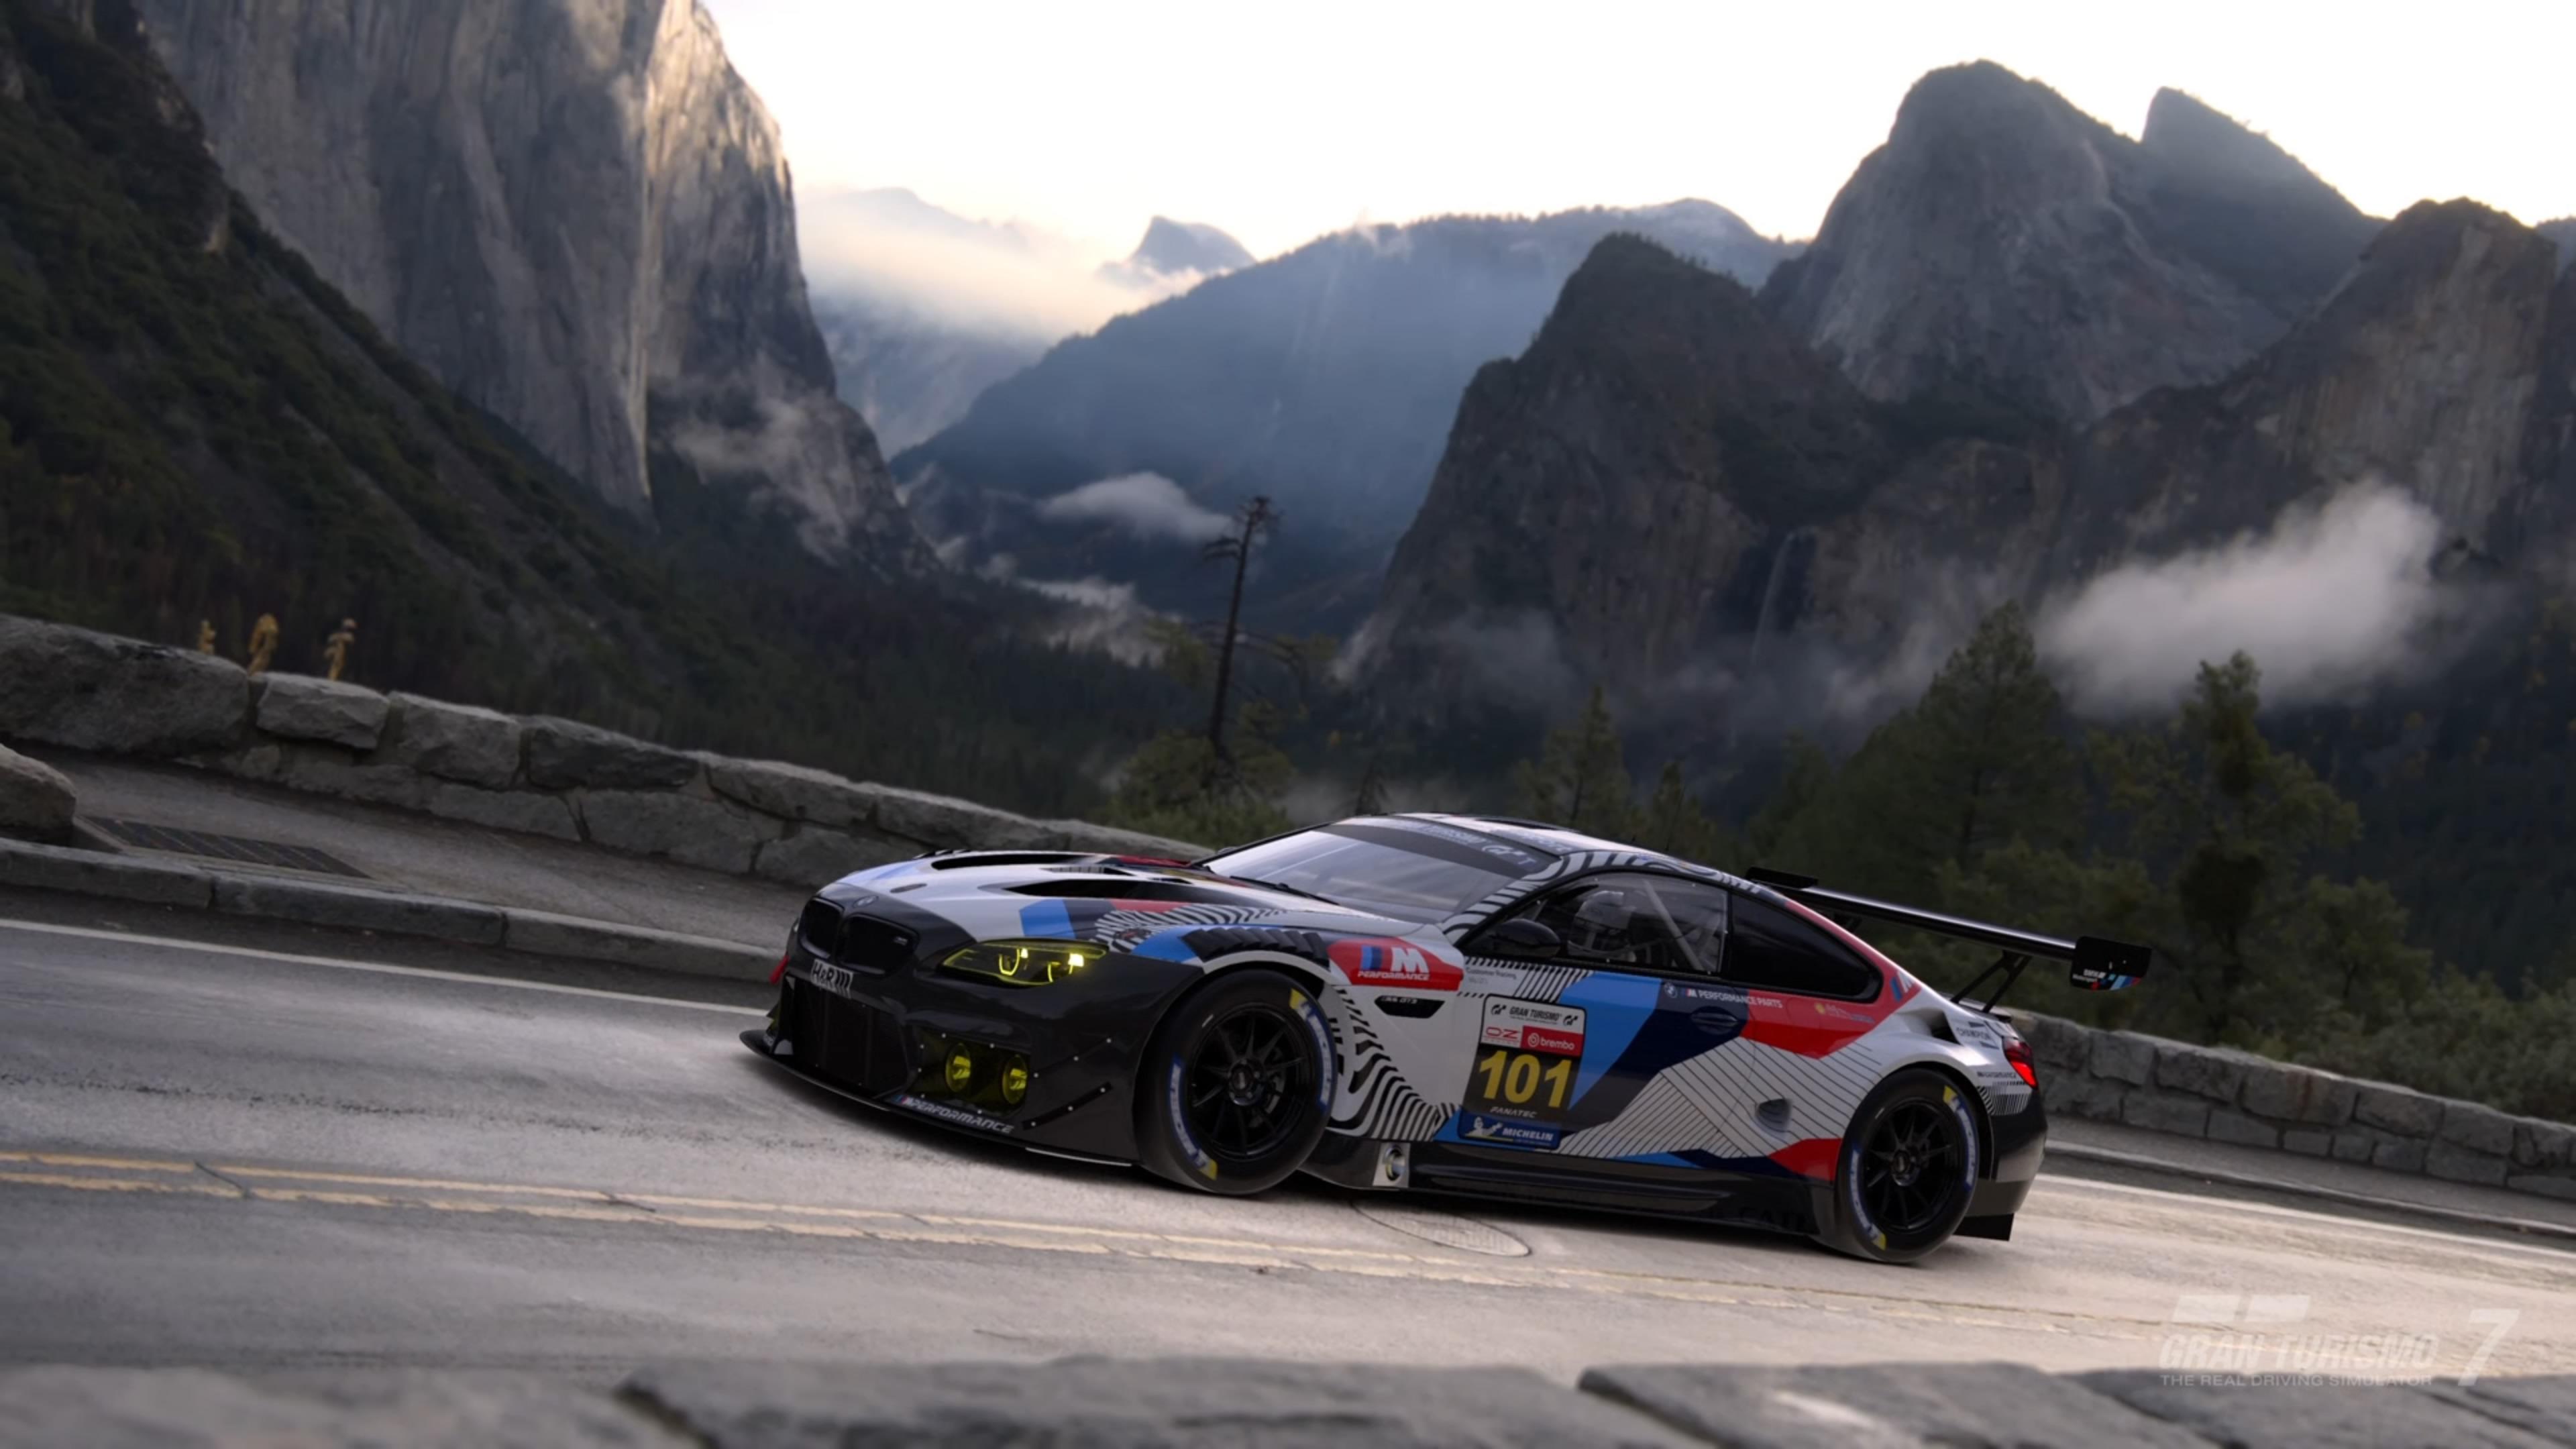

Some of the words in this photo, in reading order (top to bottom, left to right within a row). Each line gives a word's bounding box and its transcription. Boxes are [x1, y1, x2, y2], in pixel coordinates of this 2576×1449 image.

[1358, 971, 1430, 981] PERFORMANCE
[1698, 989, 1756, 1004] PERFORMANCE
[1757, 998, 1783, 1008] PARTS
[1509, 1007, 1529, 1016] GRAN
[1530, 1009, 1560, 1021] TURISMO
[1485, 1026, 1519, 1039] OZ
[1540, 1036, 1575, 1051] brembo
[1479, 1050, 1572, 1108] 101
[911, 1098, 1015, 1134] PERFORMANCE
[1489, 1106, 1538, 1118] FANATEC
[1502, 1128, 1554, 1141] MICHELIN
